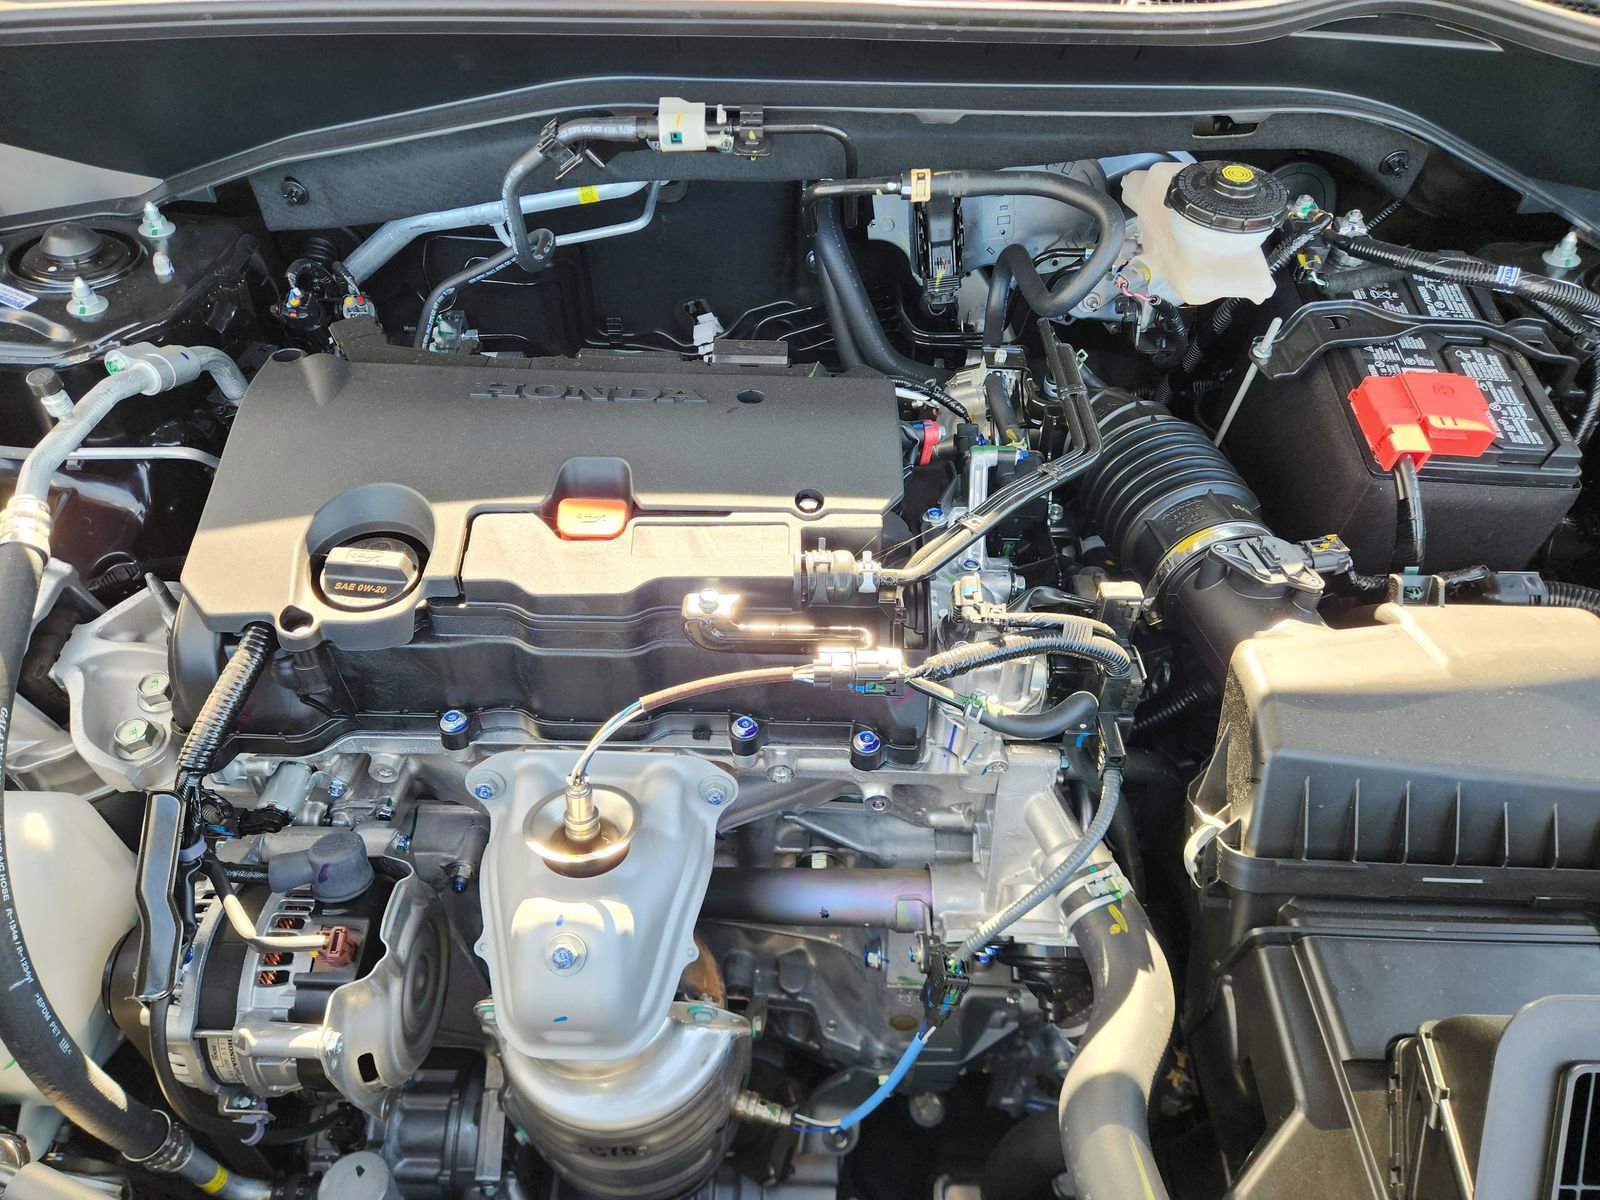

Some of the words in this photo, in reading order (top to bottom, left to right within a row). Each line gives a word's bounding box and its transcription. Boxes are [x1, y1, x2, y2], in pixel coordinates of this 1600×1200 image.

[469, 381, 708, 404] HONDA
[334, 582, 356, 591] SAE
[357, 583, 388, 594] 0W-20
[0, 873, 10, 902] HOSE
[5, 907, 19, 941] R-134a
[49, 1021, 61, 1037] PET
